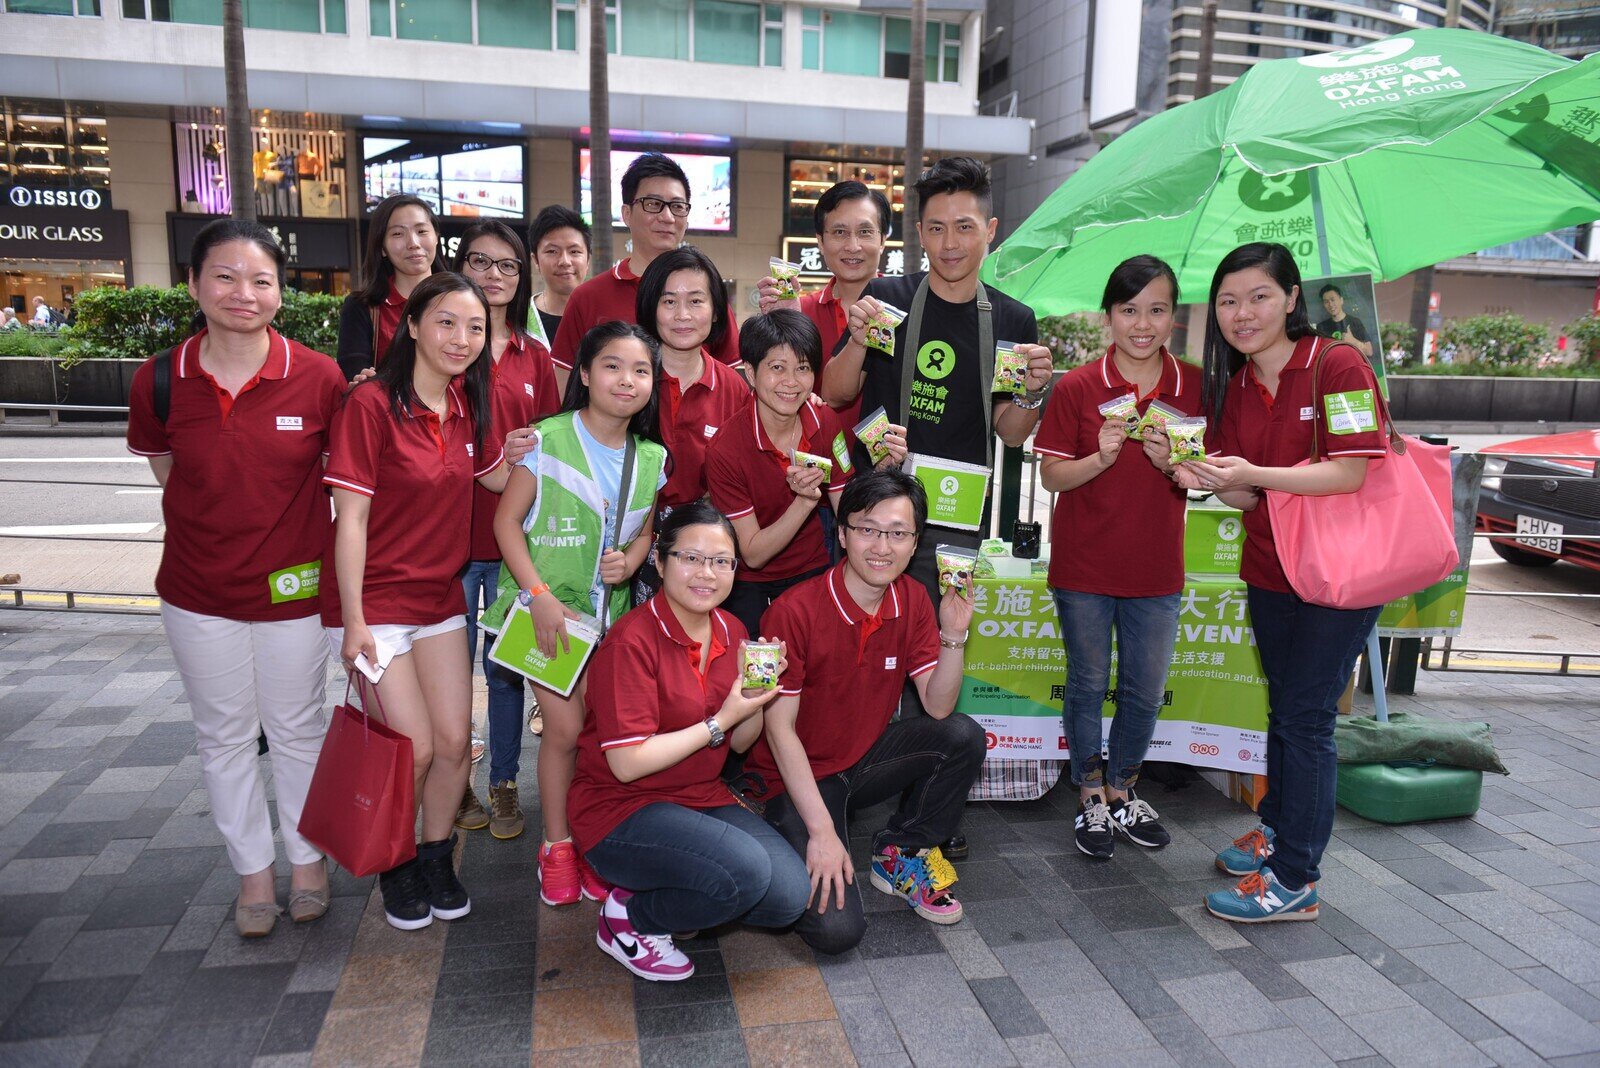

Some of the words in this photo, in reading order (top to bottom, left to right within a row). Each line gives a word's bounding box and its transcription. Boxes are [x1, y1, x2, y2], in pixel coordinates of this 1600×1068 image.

[1318, 55, 1442, 88] 樂施會
[1324, 66, 1461, 100] OXFAM
[1339, 92, 1401, 109] Hong
[1404, 80, 1467, 97] Kong
[42, 226, 104, 242] GLASS
[908, 409, 922, 420] ong
[922, 412, 941, 424] Kong
[936, 504, 956, 512] OXFAM
[1530, 518, 1550, 535] HV
[1214, 552, 1238, 560] OXFAM
[978, 620, 1065, 639] OXFA
[524, 654, 547, 669] OXFAM
[968, 662, 1023, 671] left-behind
[1025, 663, 1065, 673] children
[1182, 669, 1231, 680] education
[1234, 673, 1253, 683] and
[1191, 744, 1217, 754] TNT
